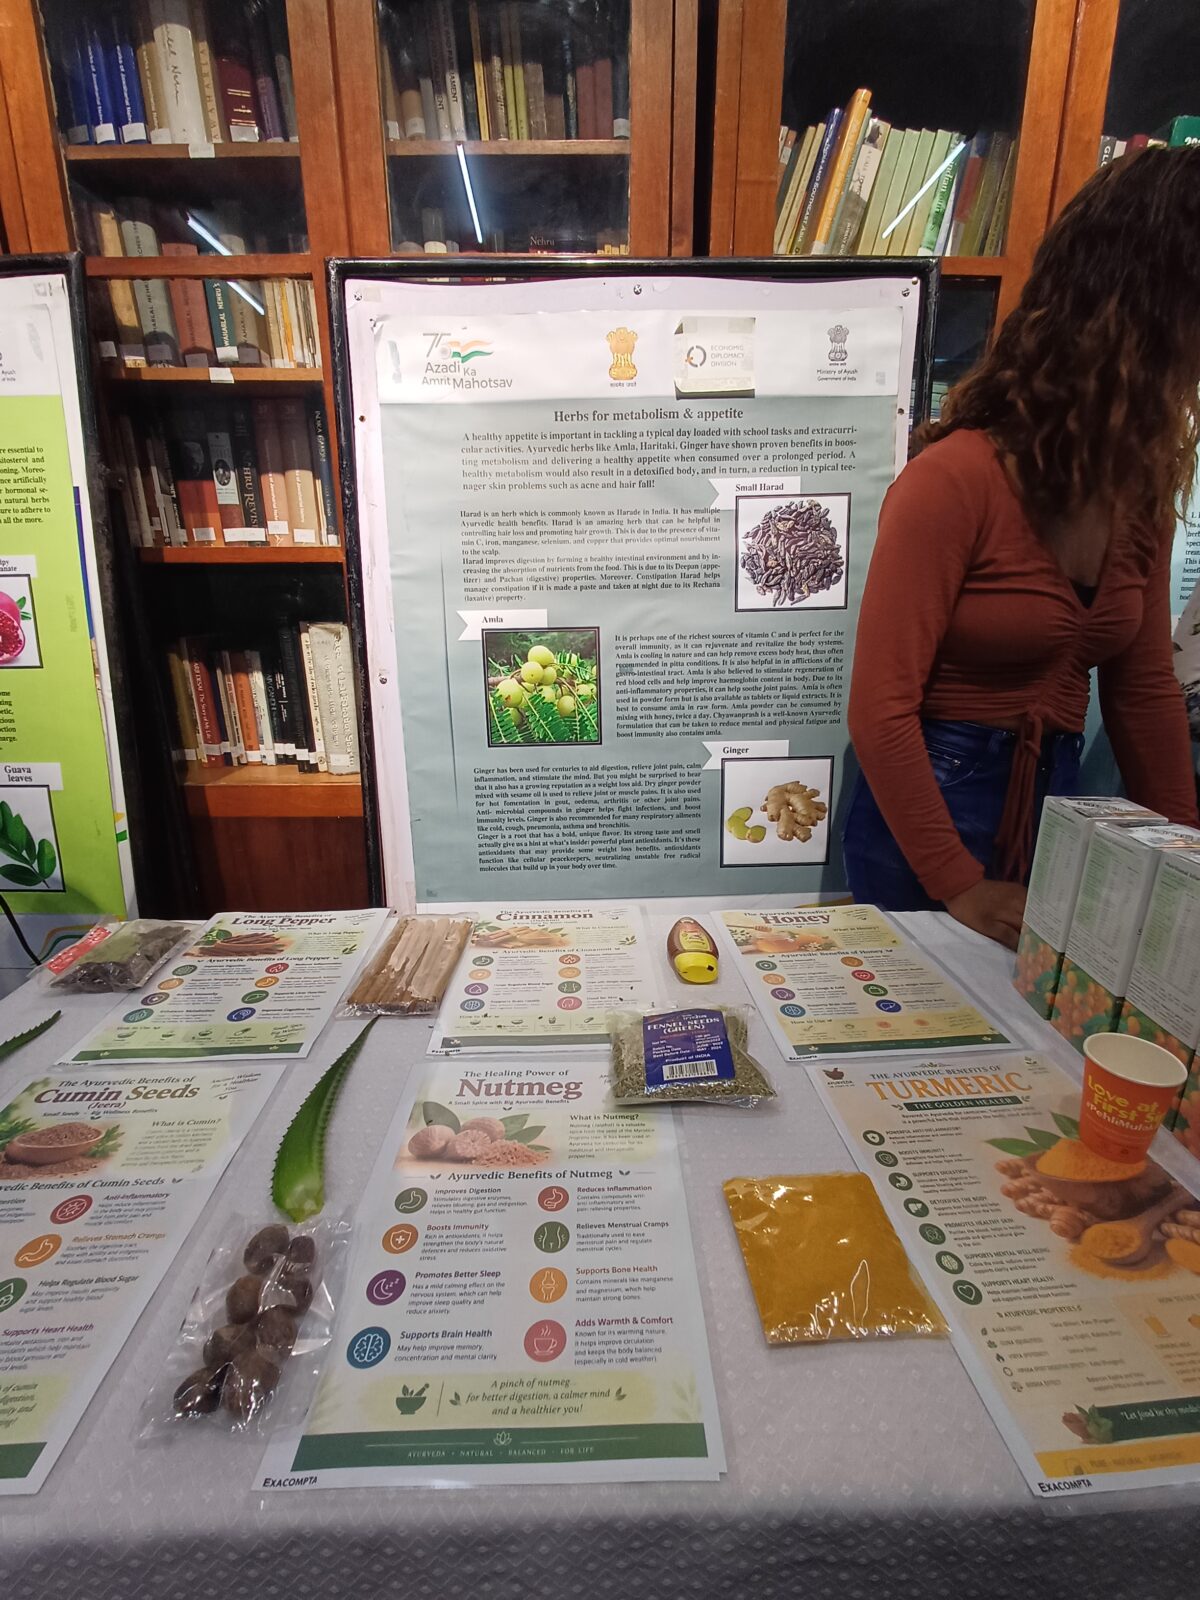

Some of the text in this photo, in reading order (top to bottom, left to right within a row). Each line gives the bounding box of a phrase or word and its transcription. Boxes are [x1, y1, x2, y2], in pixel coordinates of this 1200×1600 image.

[530, 235, 555, 246] Nehru
[425, 361, 476, 376] Azadi Ka
[422, 377, 512, 390] Amrit Mahotsav
[554, 407, 744, 422] Herbs for metabolism & appetite
[472, 433, 502, 442] healthy
[505, 433, 538, 441] appetite
[550, 432, 591, 441] important
[603, 431, 637, 440] tackling
[646, 429, 674, 438] typical
[676, 429, 691, 438] day
[693, 428, 720, 436] loaded
[723, 428, 741, 436] with
[794, 427, 809, 435] and
[736, 483, 758, 492] Small
[723, 746, 749, 756] Ginger
[4, 765, 31, 774] Guava
[8, 774, 33, 782] leaves
[572, 863, 586, 871] body
[284, 917, 336, 925] Pepper
[496, 913, 593, 921] Cinnamon
[761, 914, 830, 924] Honey
[648, 1021, 682, 1030] FENNEL
[892, 1070, 941, 1079] AYURVEDIC
[943, 1067, 987, 1075] BENEFITS
[82, 1077, 135, 1087] Ayurvedic
[138, 1076, 178, 1084] Benefits
[865, 1072, 1032, 1100] TURMERIC
[34, 1084, 200, 1103] Cumin Seeds
[456, 1078, 583, 1099] Nutmeg
[1088, 1074, 1158, 1112] Love at
[88, 1100, 126, 1110] (Jeera)
[976, 1098, 1011, 1106] HEALER
[1094, 1094, 1137, 1121] First
[448, 1172, 504, 1180] Ayurvedic
[508, 1171, 552, 1179] Benefits
[570, 1170, 612, 1179] Nutmeg
[415, 1271, 452, 1279] Promotes
[480, 1270, 501, 1279] Sleep
[576, 1267, 610, 1275] Supports
[575, 1318, 596, 1327] Adds
[598, 1317, 630, 1325] Warmth
[641, 1316, 673, 1324] Comfort
[3, 1323, 94, 1337] Supports Heart Health
[400, 1329, 492, 1340] Supports Brain Health
[499, 1379, 524, 1390] pinch
[526, 1378, 536, 1388] of
[465, 1392, 479, 1403] for
[482, 1392, 508, 1401] better
[560, 1390, 587, 1400] calmer
[590, 1389, 610, 1398] mind
[492, 1406, 509, 1415] and
[520, 1406, 560, 1415] healthier
[562, 1404, 583, 1415] you!
